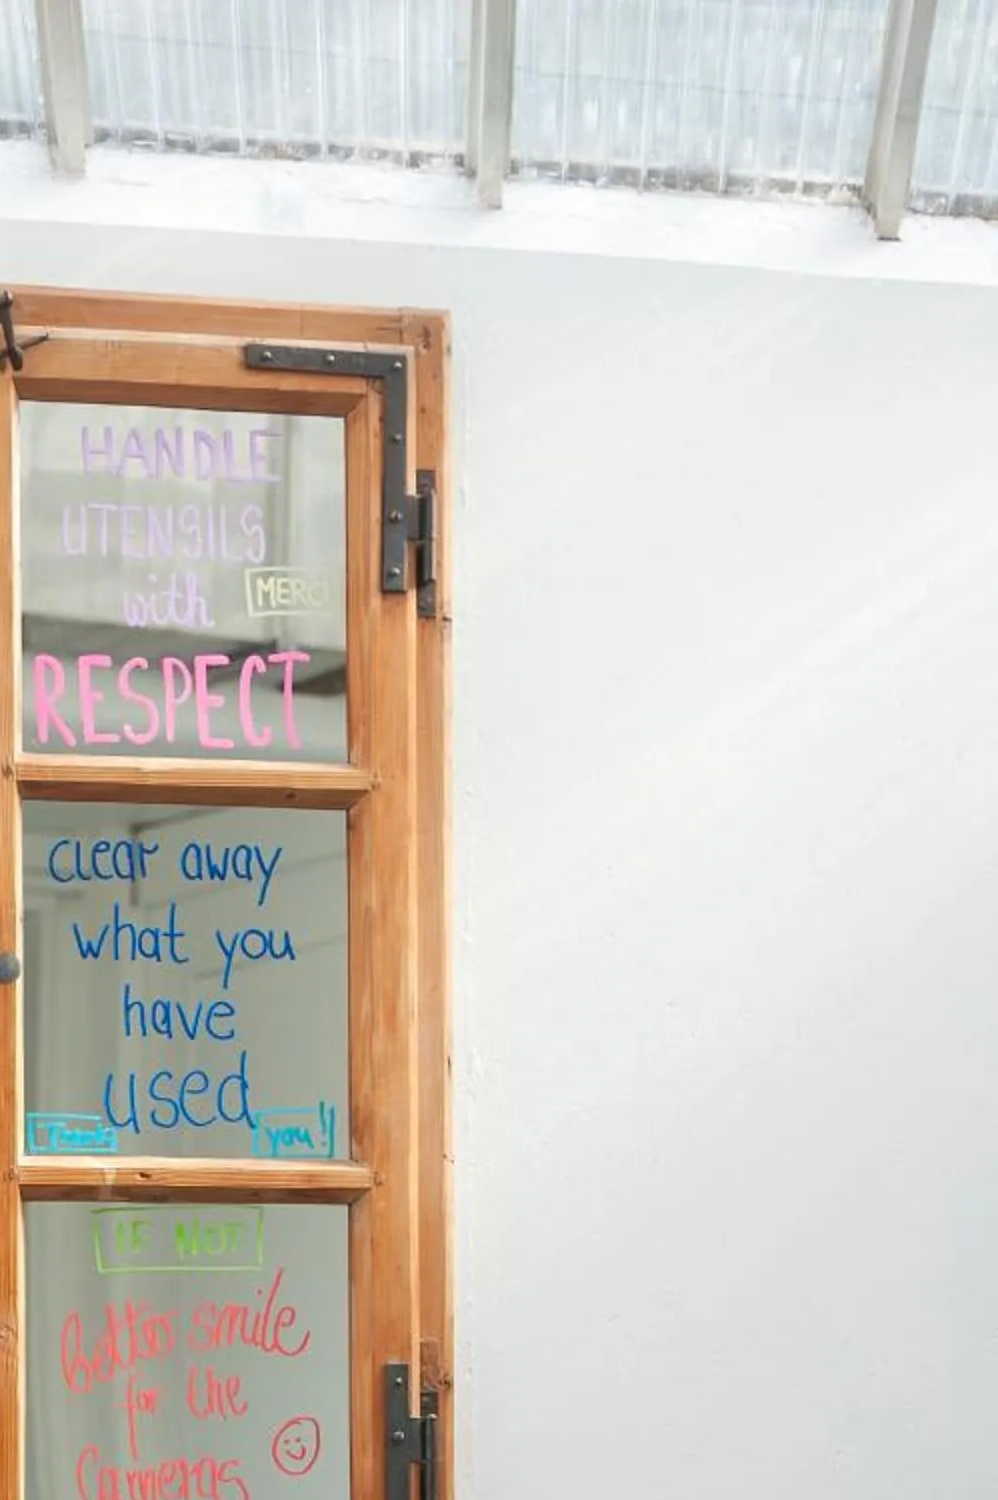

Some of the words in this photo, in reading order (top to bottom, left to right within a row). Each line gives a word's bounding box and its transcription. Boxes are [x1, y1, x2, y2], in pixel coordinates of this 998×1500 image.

[80, 425, 282, 484] HANDLE
[62, 503, 267, 564] UTENSILS
[124, 571, 215, 628] with
[33, 651, 311, 750] RESPECT
[48, 839, 160, 883] clear
[181, 842, 283, 906] away
[72, 902, 189, 963] what
[215, 928, 296, 989] you
[123, 983, 236, 1040] have
[104, 1050, 256, 1134] used
[116, 1221, 149, 1253] IF
[175, 1219, 247, 1257] NOT
[187, 1266, 310, 1357] smile
